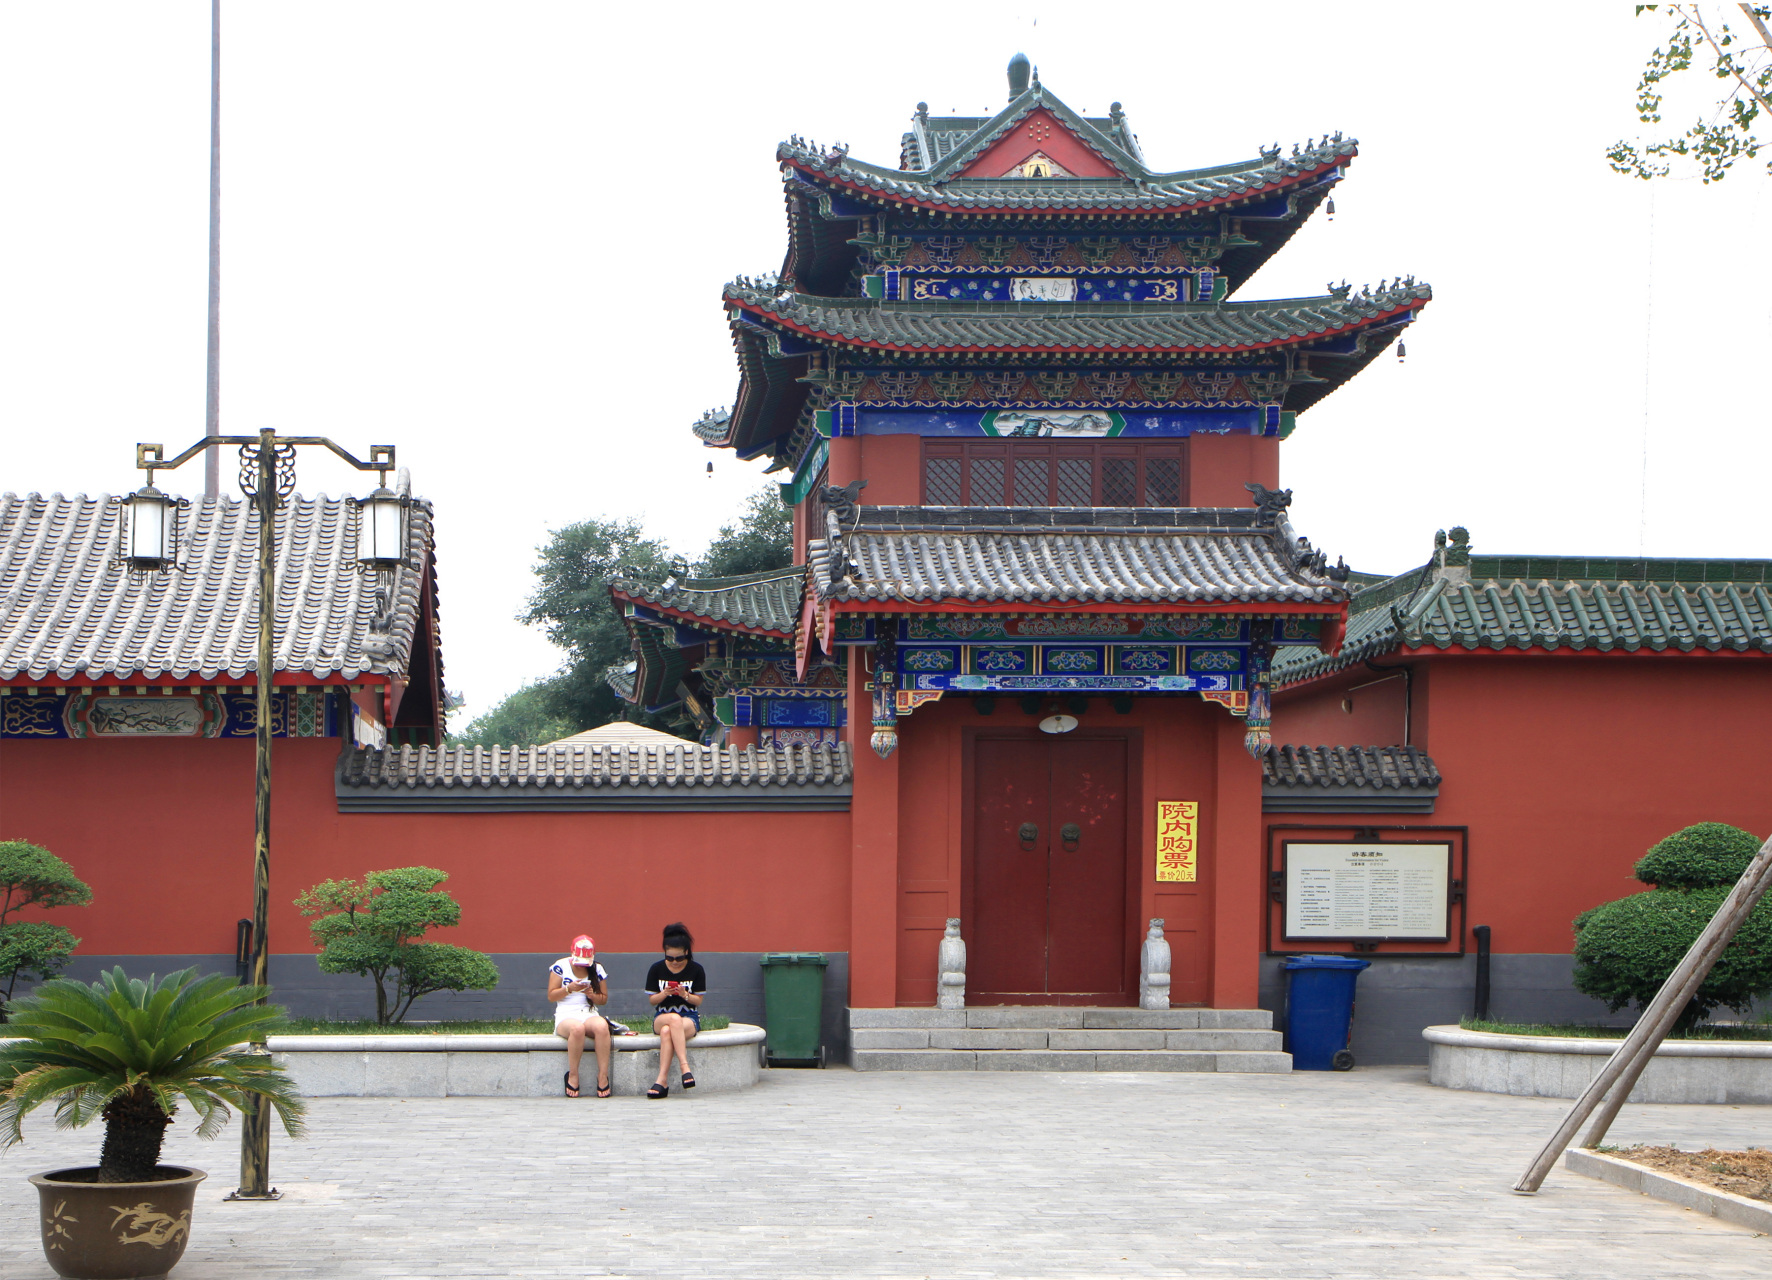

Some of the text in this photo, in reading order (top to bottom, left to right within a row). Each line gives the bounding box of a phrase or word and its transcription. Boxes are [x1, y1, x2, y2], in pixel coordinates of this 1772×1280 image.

[1159, 803, 1195, 869] 院内购票
[1158, 870, 1194, 880] 票价20元
